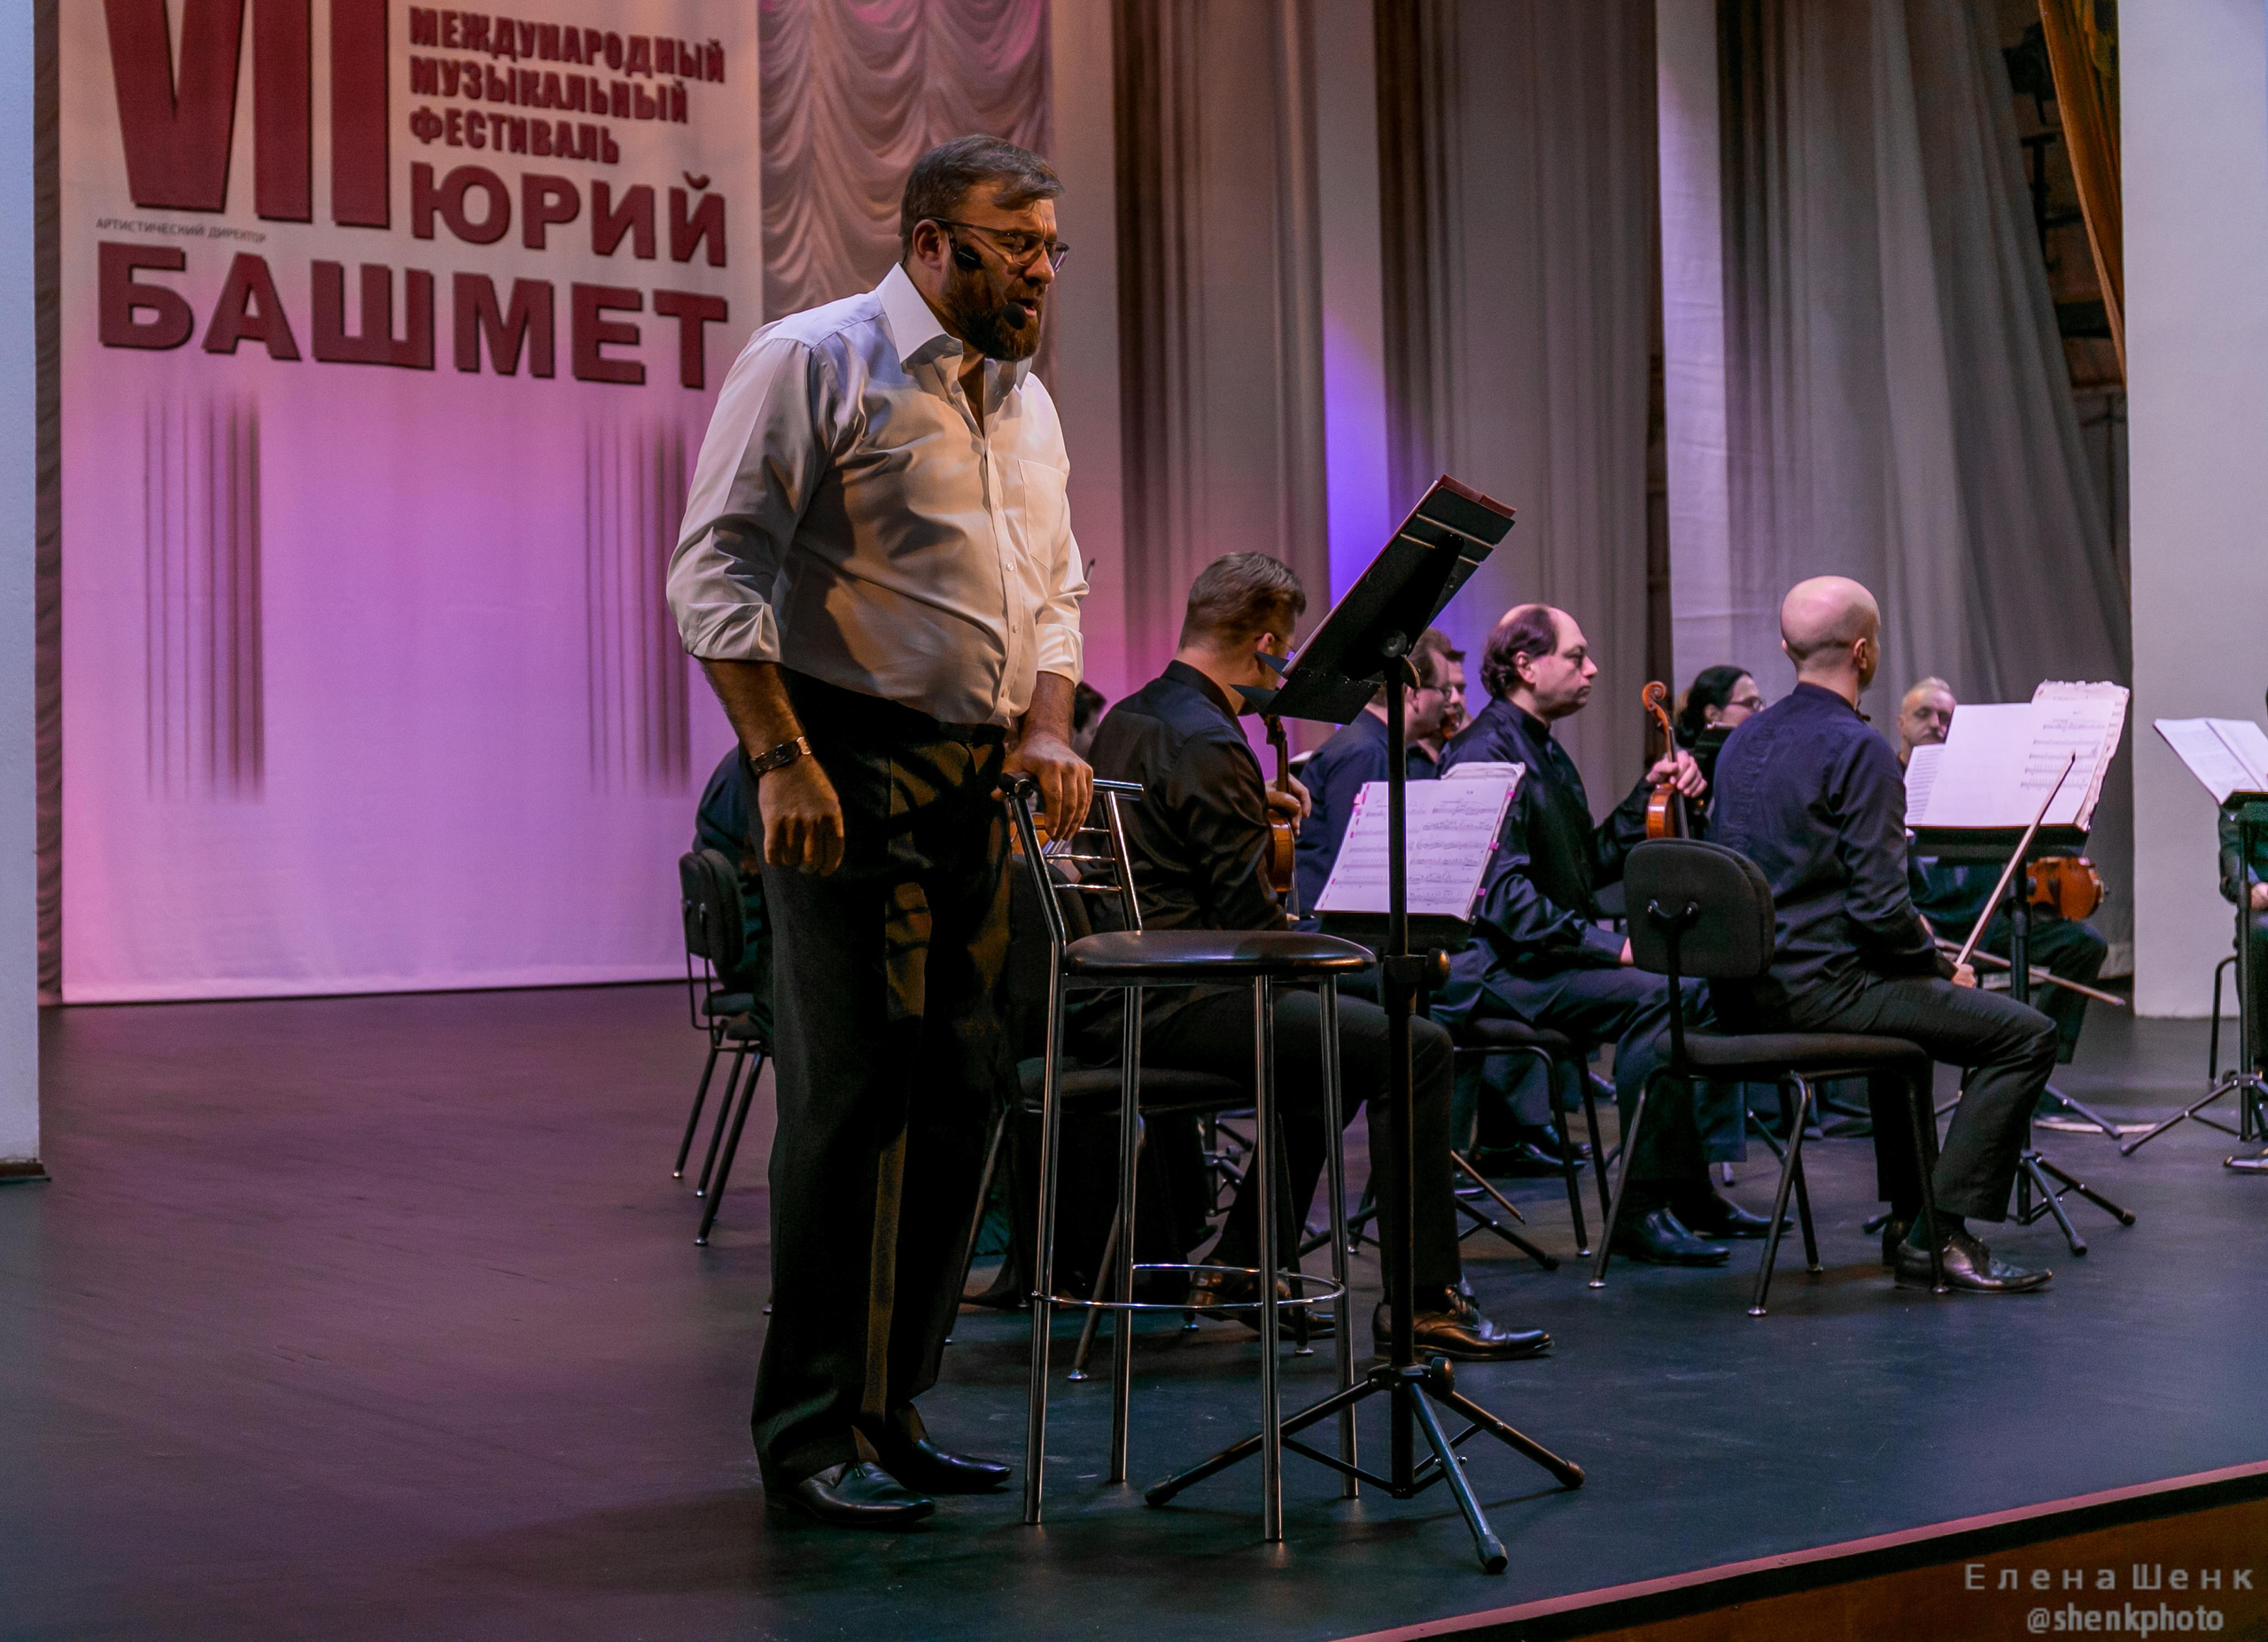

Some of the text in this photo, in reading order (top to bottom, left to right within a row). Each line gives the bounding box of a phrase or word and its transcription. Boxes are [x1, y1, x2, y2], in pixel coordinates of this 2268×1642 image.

[408, 5, 725, 83] МЕЖДУНАРОДНЫЙ
[408, 54, 688, 124] МУЗЫКАЛЬНЫЙ
[408, 105, 620, 165] ФЕСТИВАЛЬ
[96, 217, 266, 244] АРТИСТИЧЕСКИЙ ДИРЕКТОР
[410, 161, 727, 267] ЮРИЙ
[98, 241, 727, 390] БАШМЕТ
